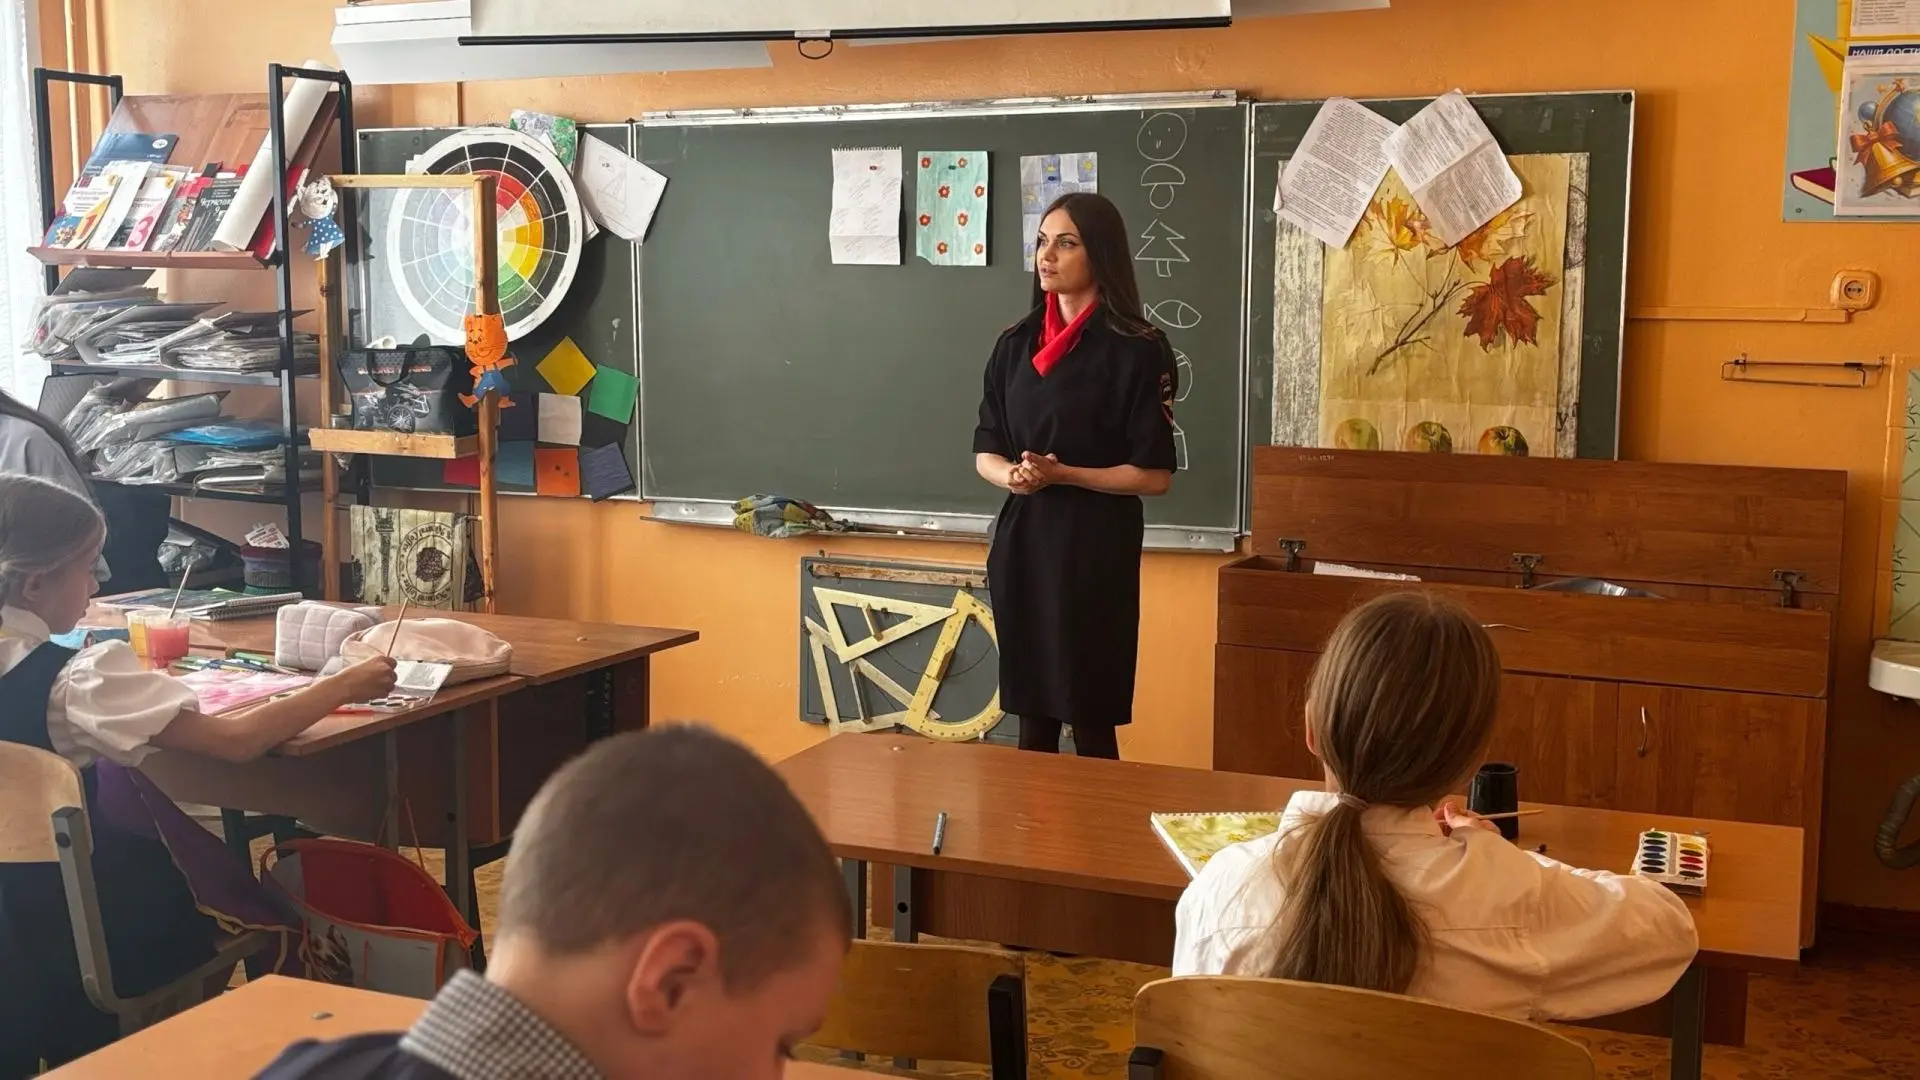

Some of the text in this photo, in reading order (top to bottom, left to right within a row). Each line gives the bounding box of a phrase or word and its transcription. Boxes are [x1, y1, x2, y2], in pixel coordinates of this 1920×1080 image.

[1852, 48, 1884, 56] НАШИ
[78, 213, 97, 239] 1
[128, 215, 154, 247] 3
